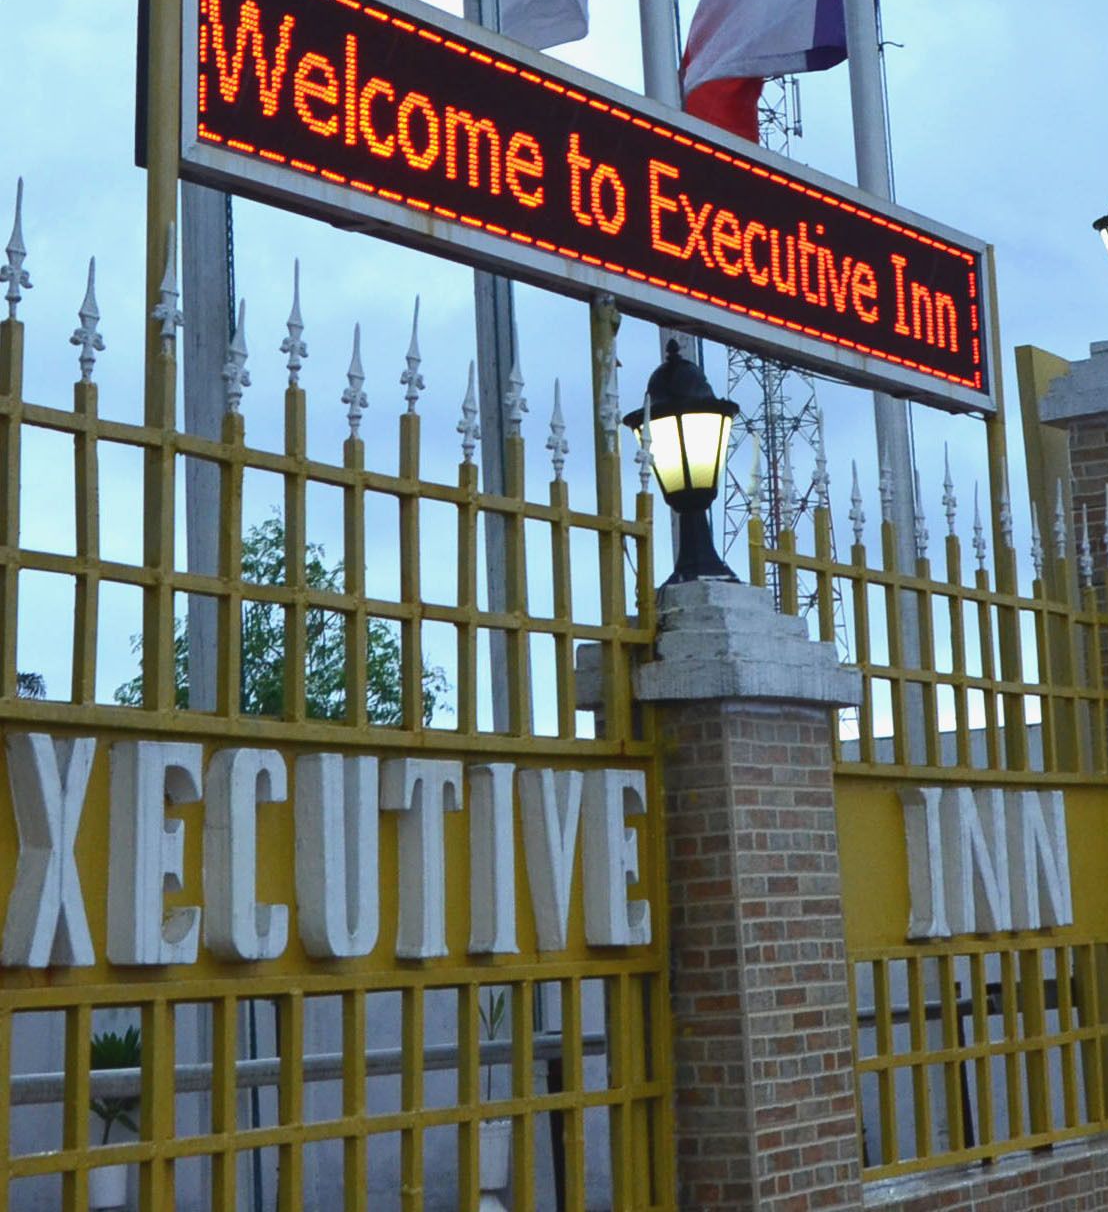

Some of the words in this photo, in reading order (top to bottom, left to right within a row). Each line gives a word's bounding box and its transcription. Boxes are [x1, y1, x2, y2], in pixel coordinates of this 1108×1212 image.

[566, 132, 628, 235] to
[648, 158, 880, 324] Executive
[890, 253, 959, 353] Inn
[2, 733, 652, 969] XECUTIVE
[902, 787, 1073, 940] INN
